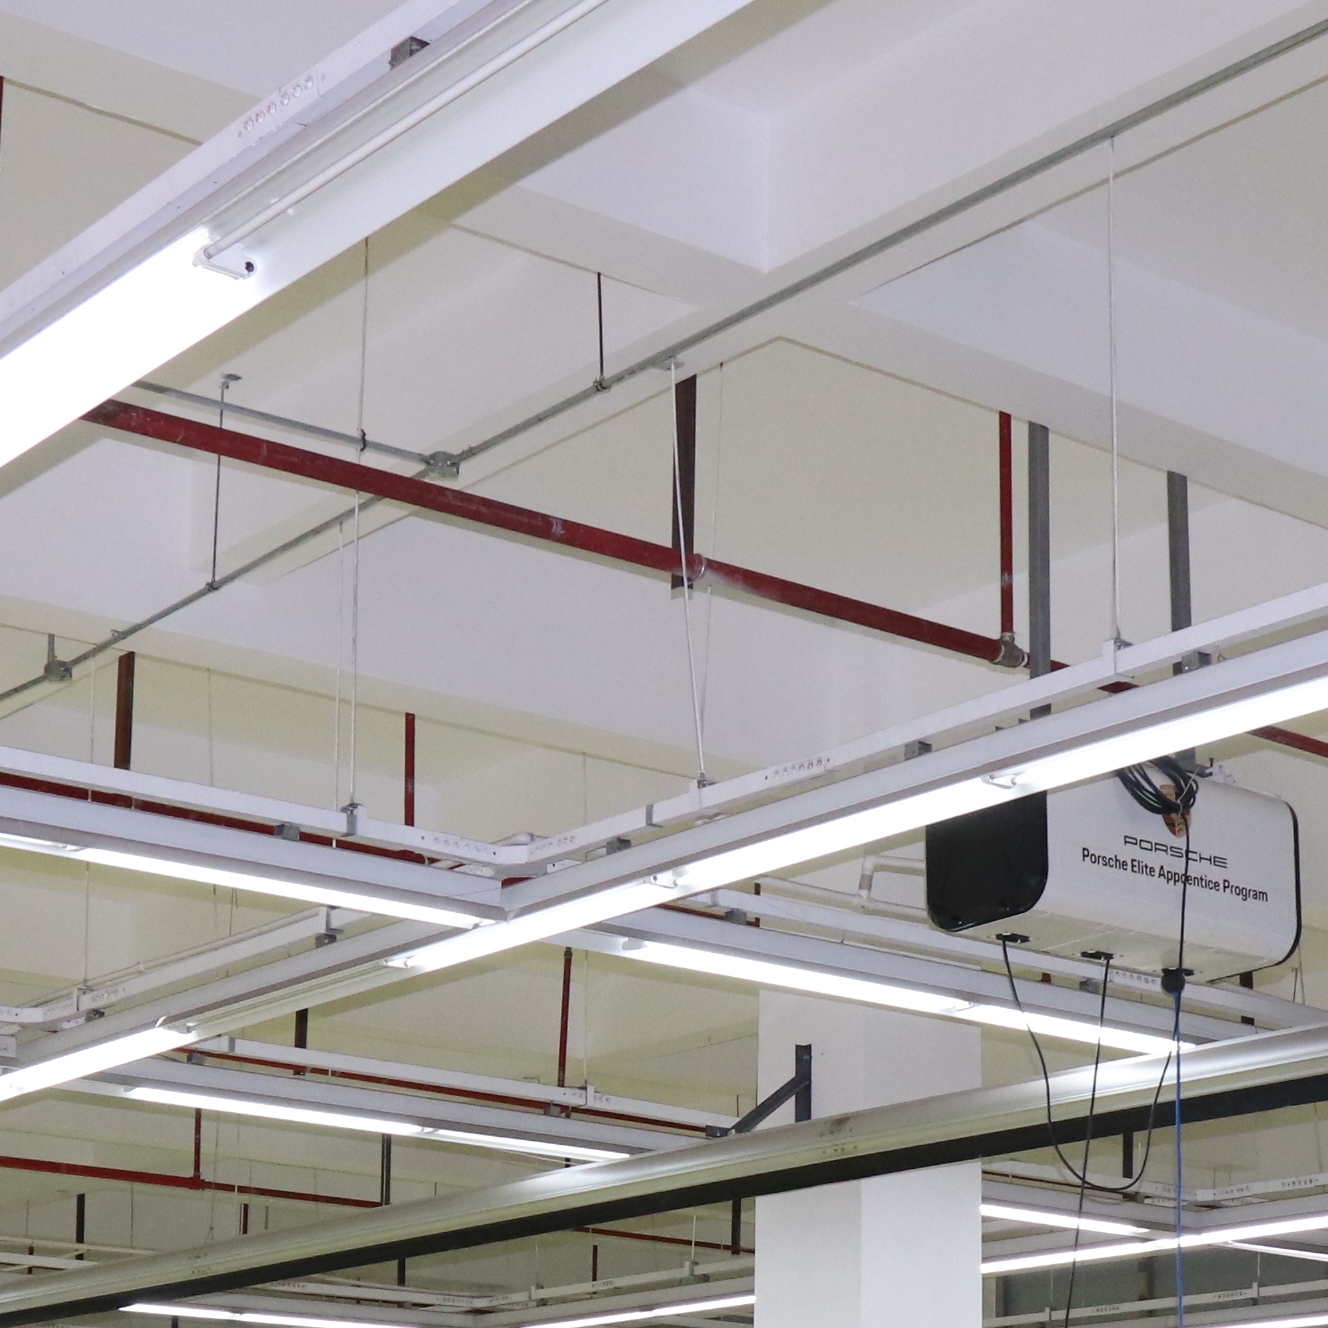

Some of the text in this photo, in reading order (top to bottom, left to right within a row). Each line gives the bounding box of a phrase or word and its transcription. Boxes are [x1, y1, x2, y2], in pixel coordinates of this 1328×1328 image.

[1124, 835, 1228, 868] PORSCHE
[1082, 847, 1128, 871] Porsche
[1131, 859, 1155, 877] Elite
[1223, 879, 1268, 902] Program
